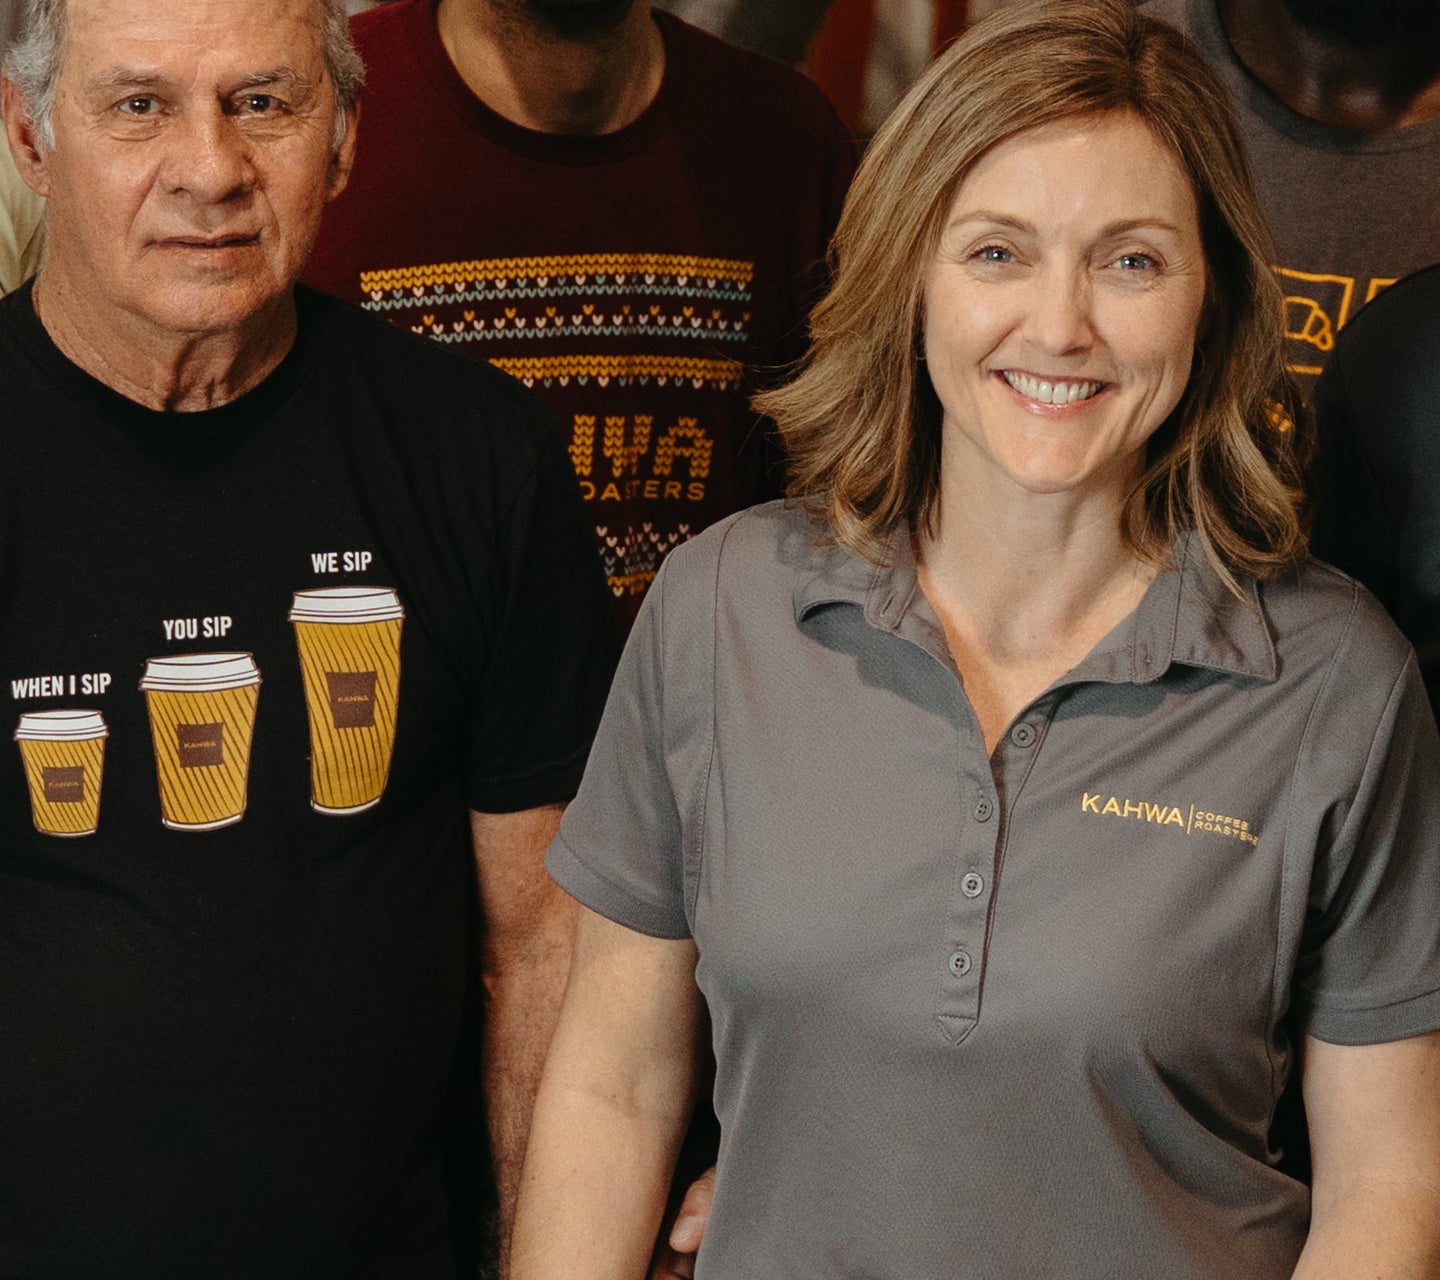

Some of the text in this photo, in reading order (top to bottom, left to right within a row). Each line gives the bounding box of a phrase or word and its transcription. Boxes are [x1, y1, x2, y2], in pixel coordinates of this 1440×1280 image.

[311, 551, 372, 573] WE SIP
[163, 616, 233, 641] YOU SIP
[11, 673, 112, 700] WHEN I SIP
[1081, 792, 1185, 827] KAHWA
[1195, 811, 1249, 831] COFFEE
[1193, 821, 1259, 846] ROASTERS
